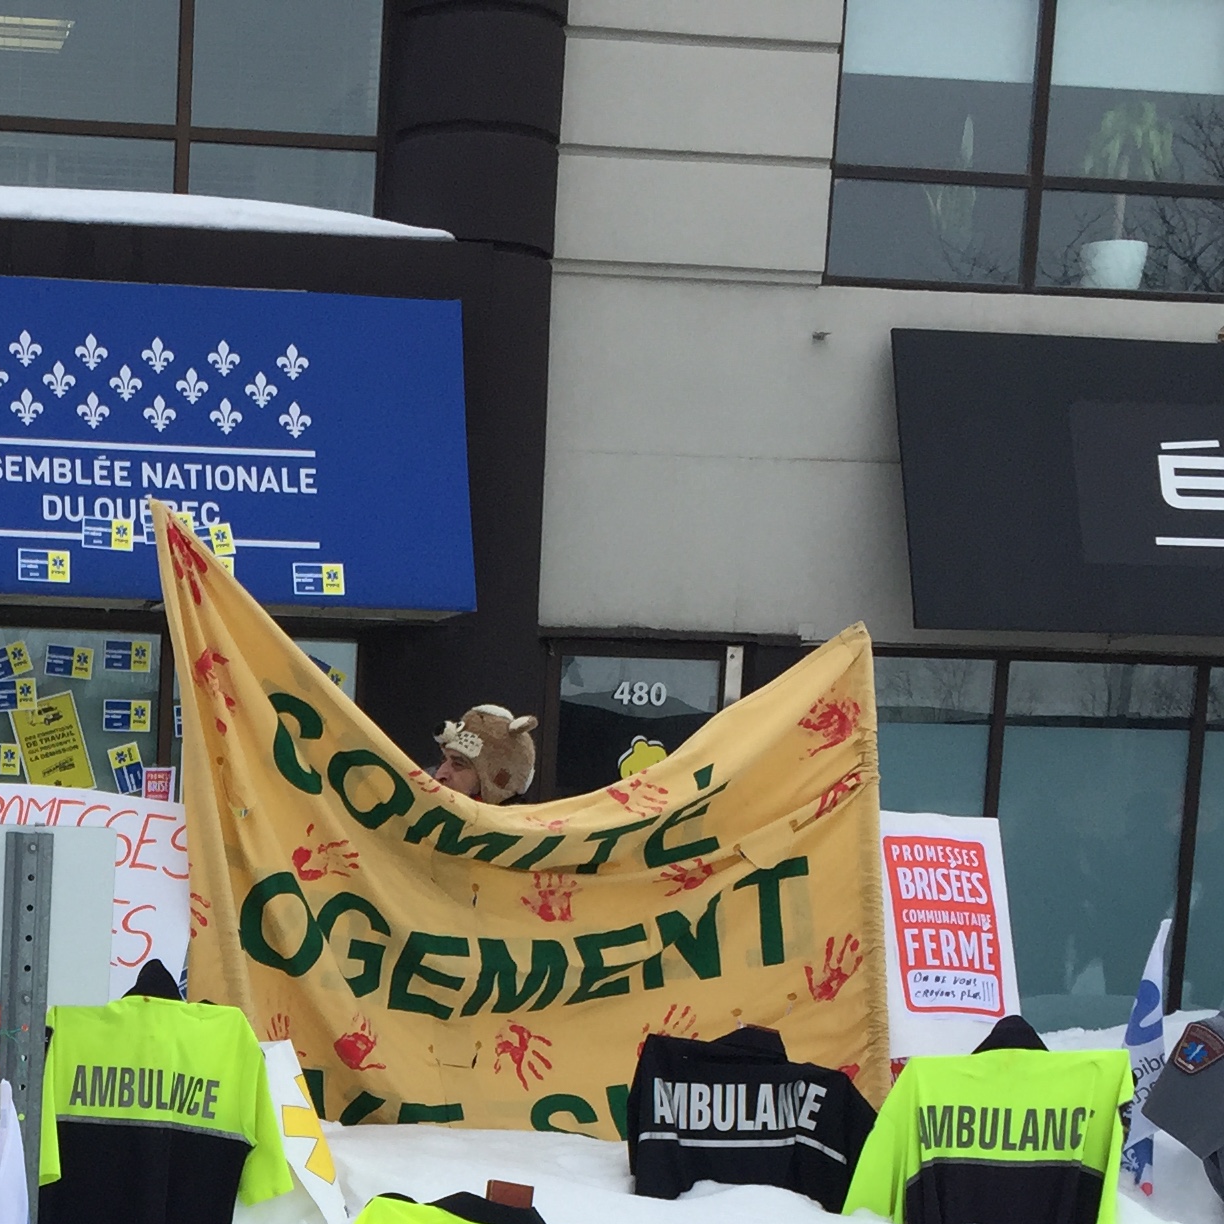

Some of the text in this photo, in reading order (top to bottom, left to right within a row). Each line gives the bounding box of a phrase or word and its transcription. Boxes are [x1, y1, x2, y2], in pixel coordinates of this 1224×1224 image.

[142, 461, 318, 494] NATIONALE
[42, 495, 221, 527] DU QUEC
[614, 681, 667, 707] 480
[891, 844, 979, 868] PROMESSES
[896, 860, 988, 905] BRISÉES
[239, 856, 809, 1020] OGEMENT
[902, 908, 992, 930] COMMUNAUTAIRE
[904, 926, 995, 971] FERMÉ
[69, 1064, 220, 1120] AMBULNCE
[919, 1105, 1095, 1152] AMBULANC
